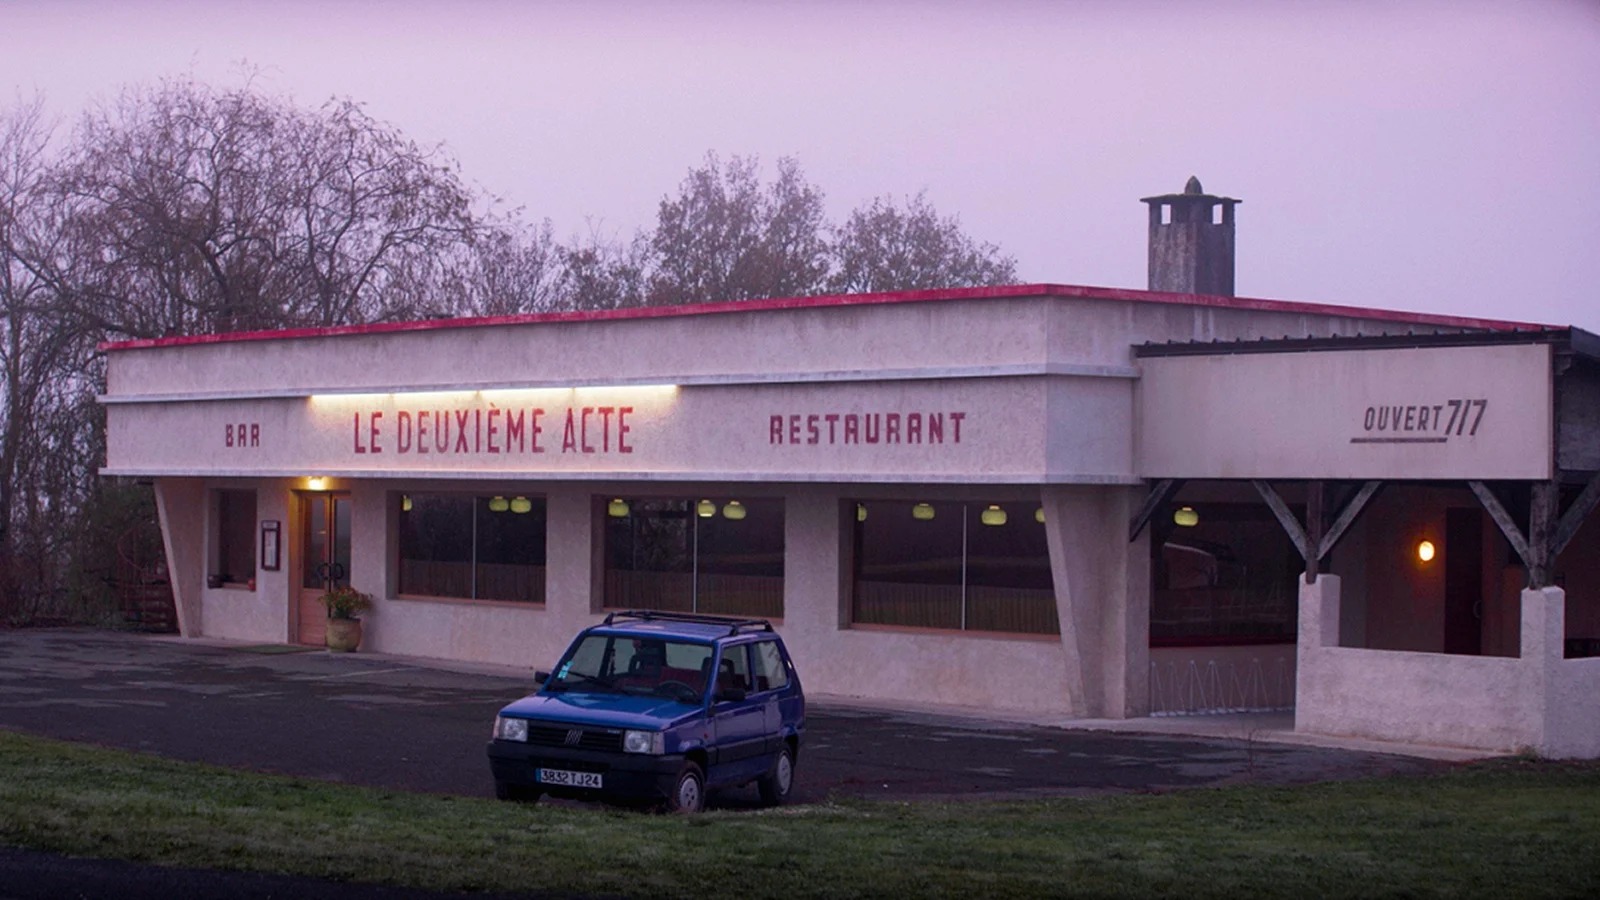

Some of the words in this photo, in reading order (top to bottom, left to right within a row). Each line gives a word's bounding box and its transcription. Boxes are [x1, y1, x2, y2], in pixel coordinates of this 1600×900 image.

[354, 411, 383, 454] LE
[397, 401, 545, 454] DEUXIÈME
[562, 406, 634, 454] ACTE
[769, 412, 967, 445] RESTAURANT
[1363, 405, 1443, 432] OUVERT
[1444, 399, 1488, 436] 7/7
[225, 423, 260, 448] BAR
